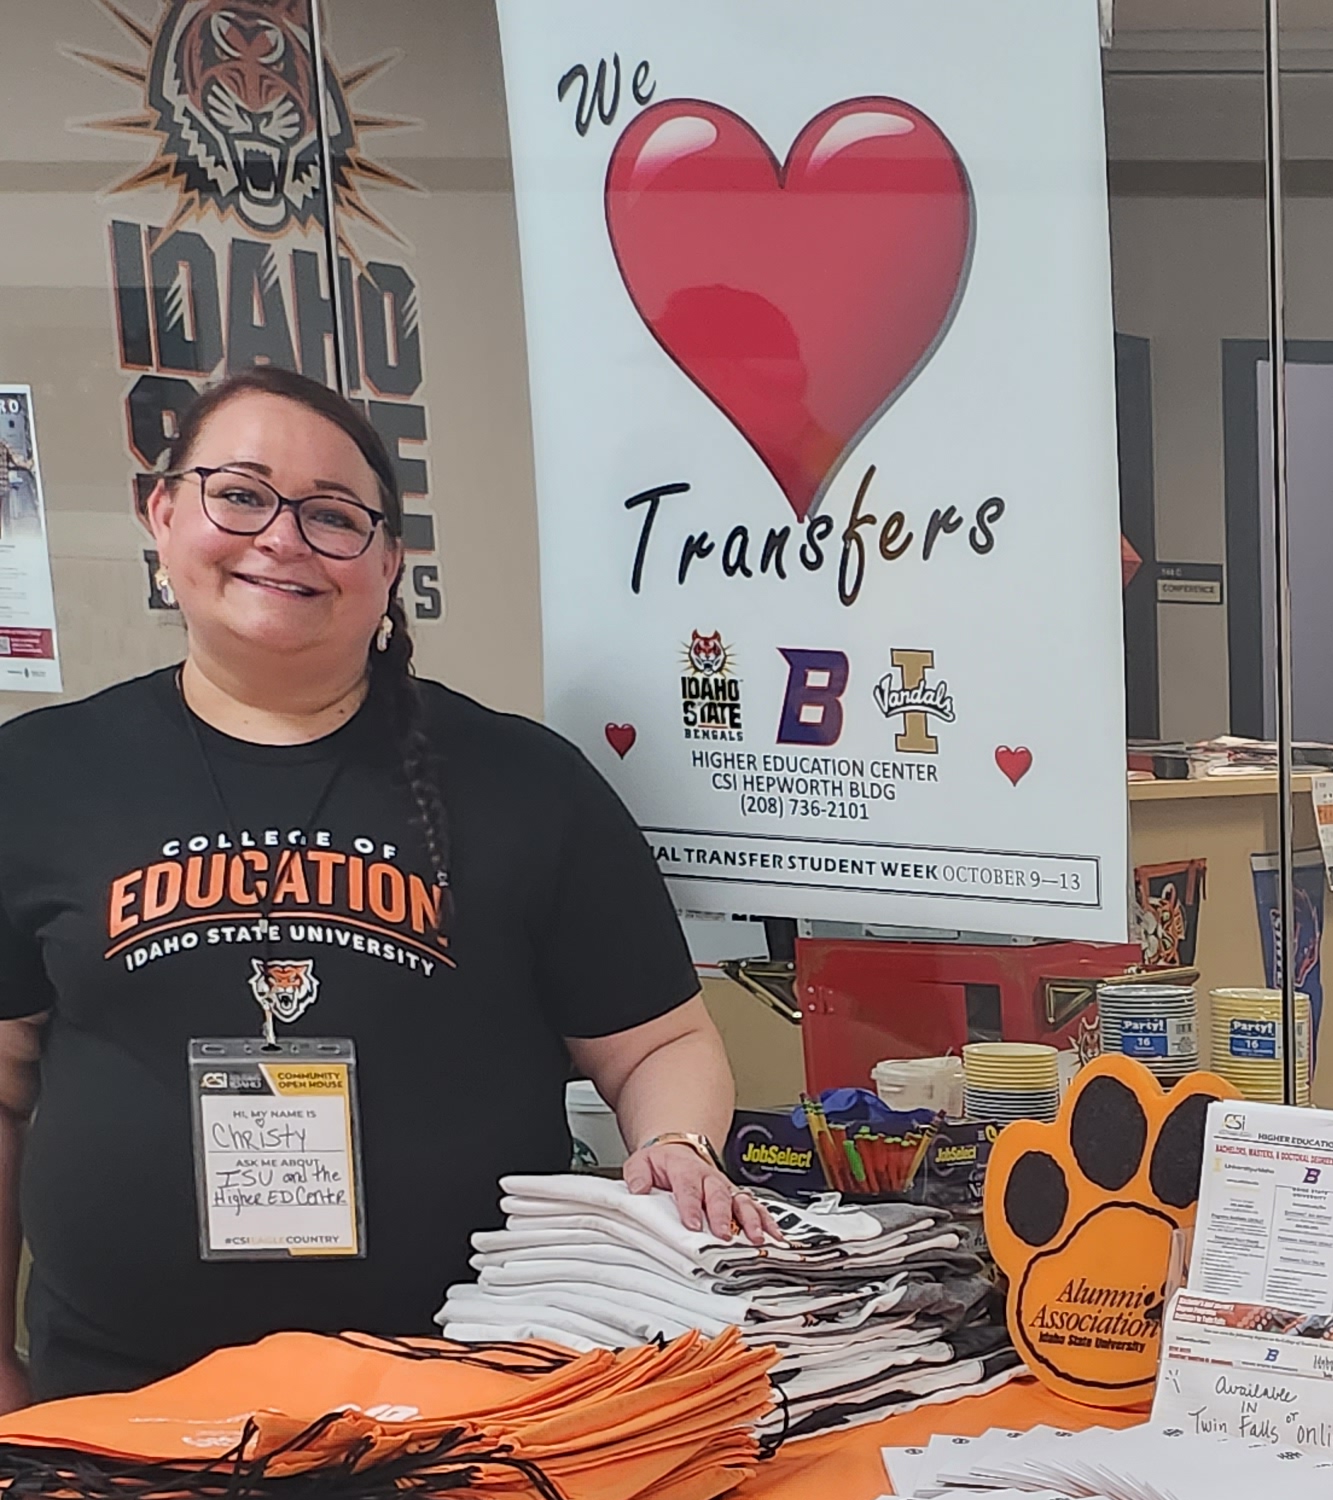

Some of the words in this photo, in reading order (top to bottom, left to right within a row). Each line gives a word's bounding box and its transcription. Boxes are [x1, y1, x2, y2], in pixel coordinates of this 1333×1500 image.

[557, 51, 656, 137] We
[109, 218, 425, 398] IDAHO
[624, 464, 1006, 607] Transfers
[681, 676, 740, 702] IDAHO
[776, 647, 851, 747] B
[873, 673, 956, 722] Vandals
[683, 701, 742, 729] STATE
[684, 729, 744, 742] BENGALS
[691, 750, 758, 772] HIGHER
[762, 754, 866, 778] EDUCATION
[869, 760, 939, 783] CENTER
[711, 773, 738, 791] CSI
[742, 775, 845, 799] HEPWORTH
[849, 779, 897, 801] BLDG
[739, 796, 784, 818] (208)
[788, 798, 870, 821] 736-2101
[161, 830, 331, 857] COLLEGE
[353, 838, 399, 860] OF
[684, 848, 784, 870] TRANSFER
[787, 856, 876, 877] STUDENT
[880, 861, 939, 881] WEEK
[942, 864, 1027, 888] OCTOBER
[109, 850, 449, 947] EDUCATION
[125, 931, 198, 972] IDAHO
[206, 924, 281, 944] STATE
[289, 925, 435, 977] UNIVERSITY
[1122, 1019, 1165, 1032] Party!
[1232, 1021, 1274, 1035] Party!
[1137, 1037, 1151, 1047] 16
[1244, 1039, 1259, 1049] 16
[204, 1072, 228, 1088] CSI
[277, 1072, 341, 1081] COMMUNITY
[278, 1080, 306, 1089] OPEN
[308, 1080, 343, 1089] HOUSE
[251, 1110, 267, 1119] MY
[270, 1110, 304, 1118] NAME
[306, 1110, 317, 1118] IS
[1223, 1113, 1246, 1131] CSI
[1257, 1132, 1291, 1144] HIGHER
[235, 1158, 259, 1168] ASK
[261, 1158, 277, 1167] ME
[280, 1158, 320, 1168] ABOUT
[742, 1143, 813, 1168] JobSelect
[935, 1146, 977, 1163] JobSelect
[216, 1168, 273, 1189] ISU
[312, 1163, 343, 1183] the
[1302, 1166, 1322, 1185] B
[1056, 1277, 1148, 1309] Alumni
[1028, 1304, 1159, 1339] Association
[1038, 1331, 1066, 1345] Idaho
[1067, 1334, 1093, 1348] State
[1094, 1336, 1146, 1354] University
[1264, 1348, 1280, 1363] B
[1215, 1376, 1298, 1404] Available
[1240, 1401, 1258, 1414] IN
[1188, 1406, 1228, 1435] Twin
[1238, 1415, 1280, 1444] Falls
[1285, 1411, 1299, 1424] or
